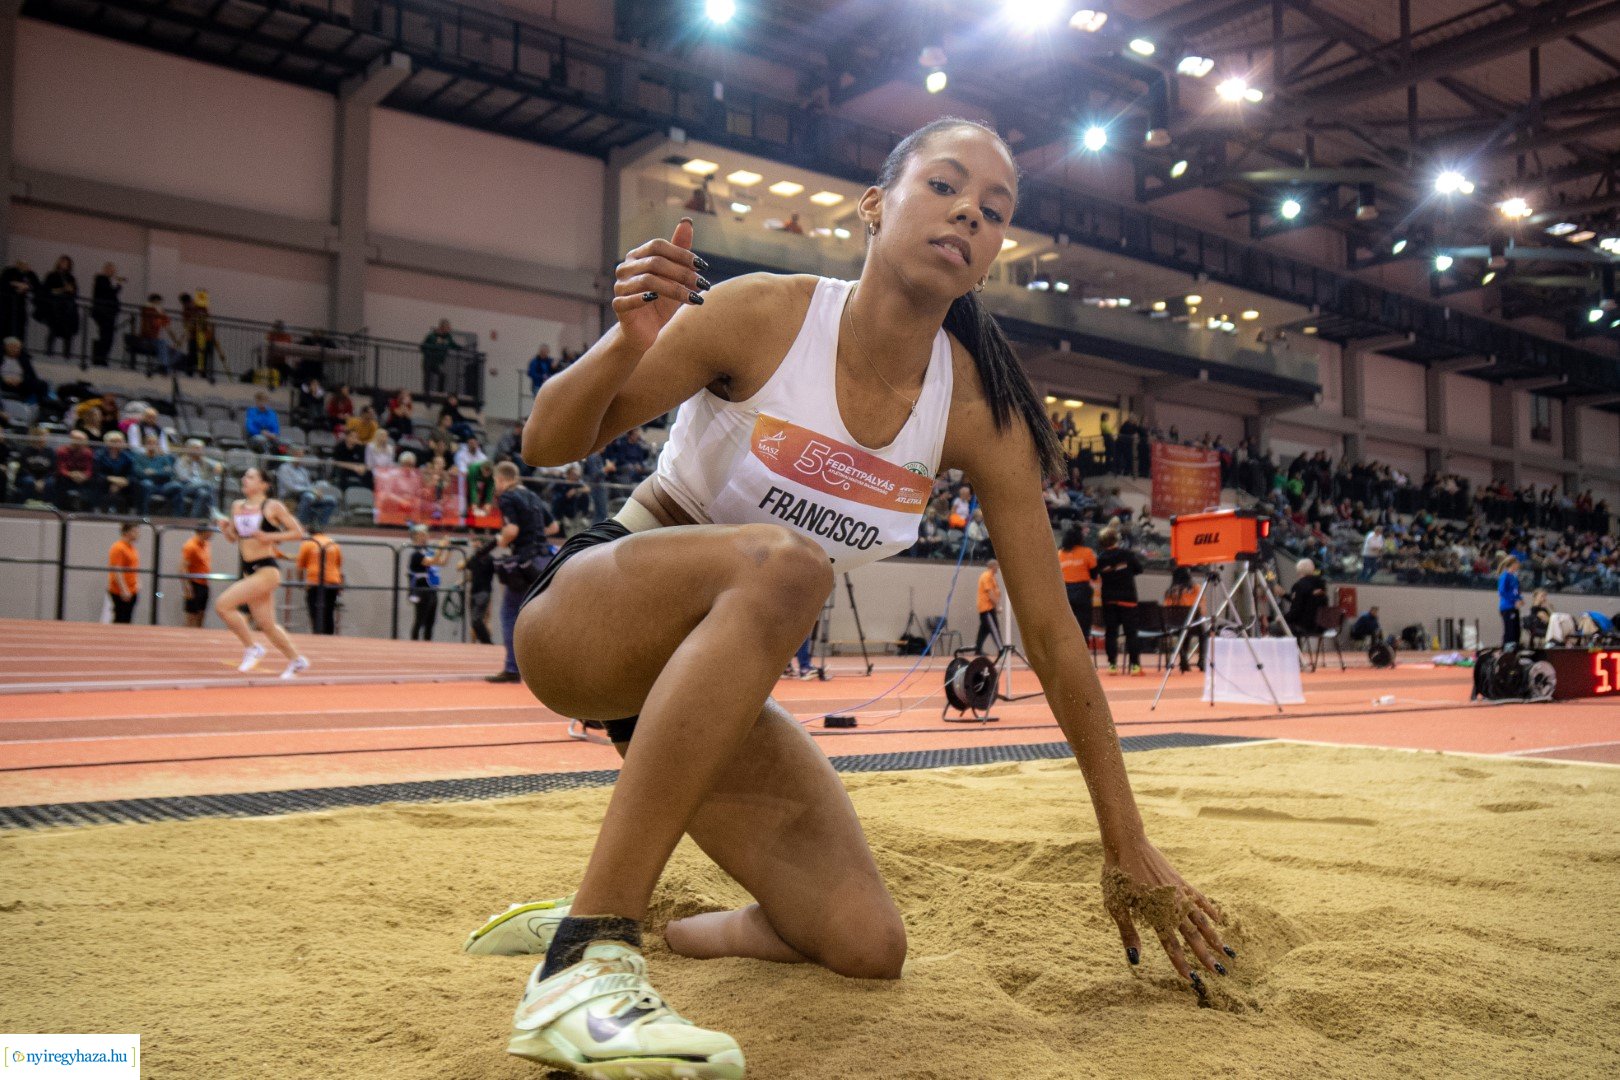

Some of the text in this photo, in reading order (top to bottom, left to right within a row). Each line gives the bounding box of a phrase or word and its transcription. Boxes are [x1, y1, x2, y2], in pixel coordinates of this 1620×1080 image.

[758, 443, 779, 455] MASZ
[825, 457, 895, 491] FEDETTPÁLYÁS
[758, 485, 883, 550] FRANCISCO-
[1193, 532, 1220, 546] GILL
